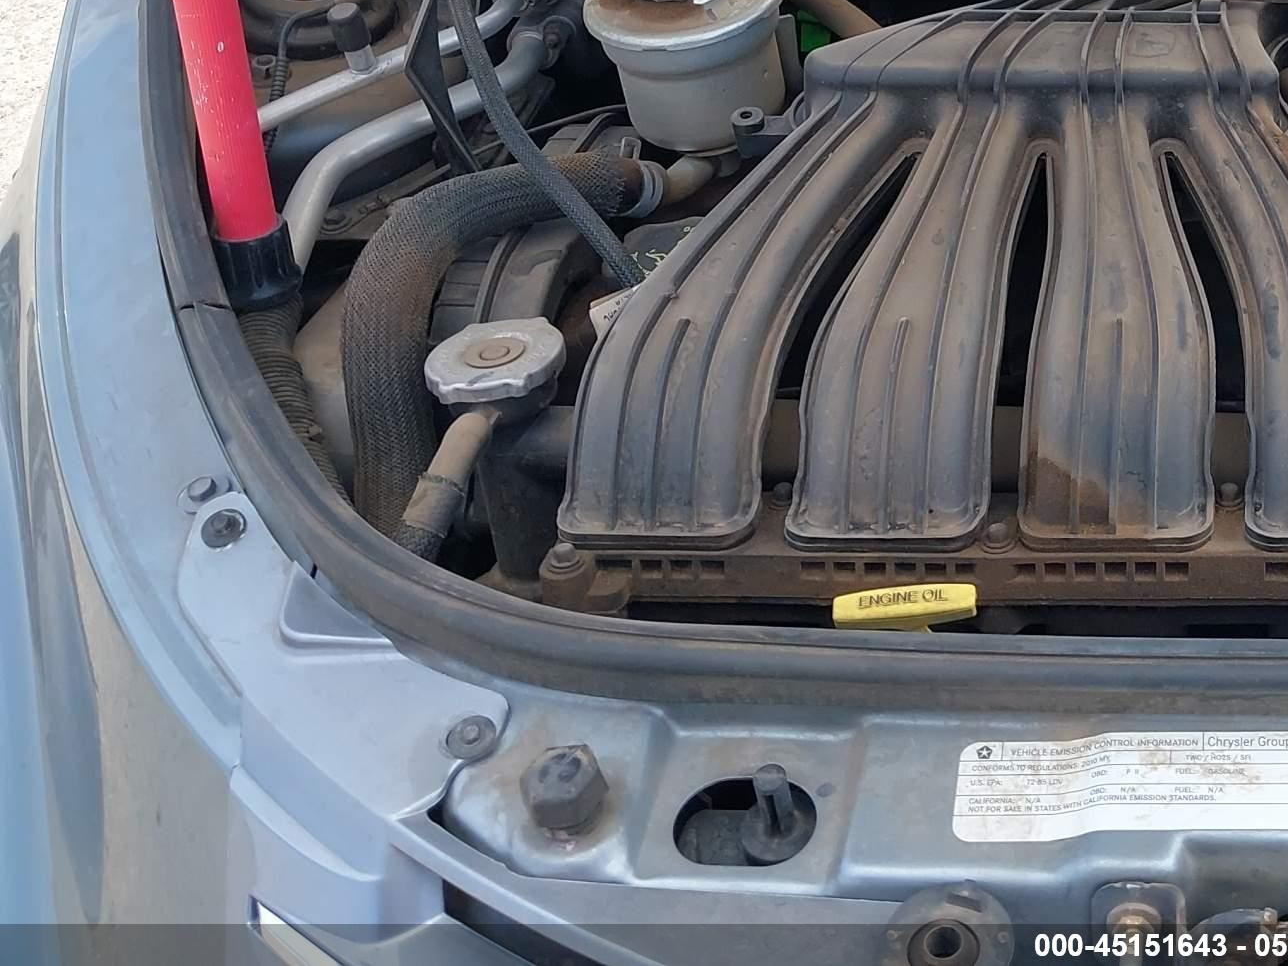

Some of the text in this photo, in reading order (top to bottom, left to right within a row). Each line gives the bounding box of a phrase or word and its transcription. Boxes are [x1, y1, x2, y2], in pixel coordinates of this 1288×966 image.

[857, 588, 948, 610] ENGINE OIL
[1011, 738, 1199, 757] VEHICLE EMISSION CONTROL INFORMATION
[1207, 736, 1255, 750] Chrysler
[971, 764, 1015, 772] CONFORMS
[1016, 764, 1026, 772] TO
[1120, 786, 1136, 794] N/A
[1207, 786, 1224, 794] N/A
[967, 805, 985, 813] NOT
[985, 805, 1001, 813] FOR
[1003, 805, 1022, 813] SALE
[1034, 804, 1062, 812] STATES
[1063, 800, 1083, 810] WITH
[1083, 794, 1127, 806] CALIFORNIA
[1168, 794, 1217, 802] STANDARDS.
